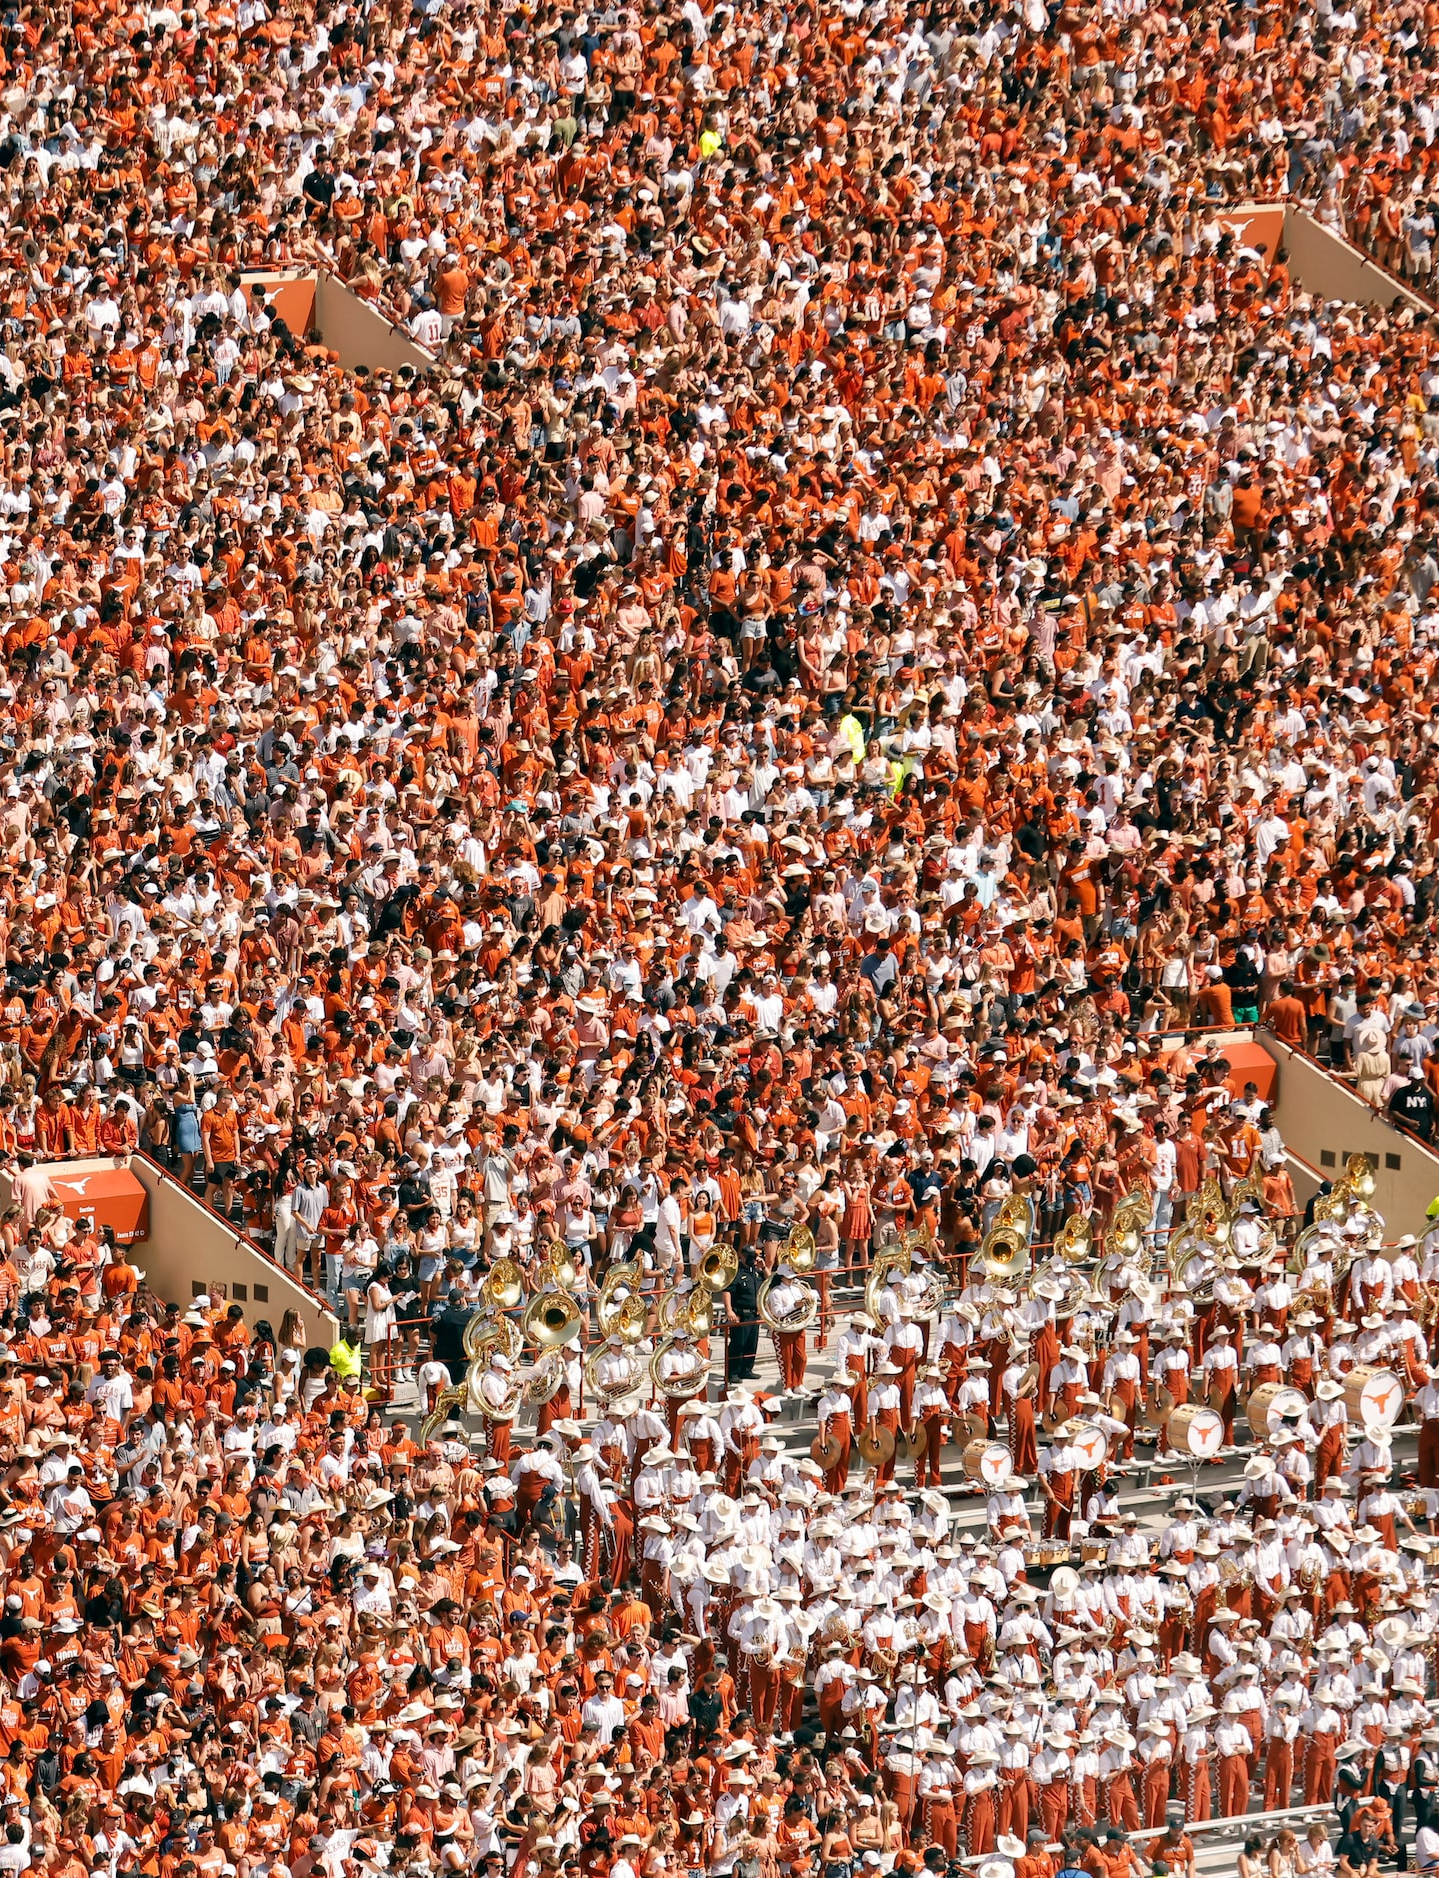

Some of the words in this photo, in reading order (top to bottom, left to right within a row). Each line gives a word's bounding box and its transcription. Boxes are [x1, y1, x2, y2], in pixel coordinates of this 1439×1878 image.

[197, 302, 219, 312] TEXAS
[864, 302, 880, 322] 10
[428, 323, 440, 341] 11
[925, 592, 933, 608] 1
[1099, 784, 1106, 804] 1
[832, 950, 850, 958] TEXAS
[4, 1007, 22, 1017] TEXAS
[104, 1024, 120, 1034] TEXAS
[1231, 1140, 1247, 1159] 11
[434, 1186, 448, 1199] 35
[16, 1258, 47, 1269] TEAS
[48, 1343, 67, 1354] TEXAS
[94, 1384, 120, 1397] TEXAS
[268, 1432, 292, 1441] TEXAS
[445, 1642, 466, 1653] TEXAS
[56, 1650, 78, 1659] HOOK
[790, 1831, 809, 1839] TEXAS
